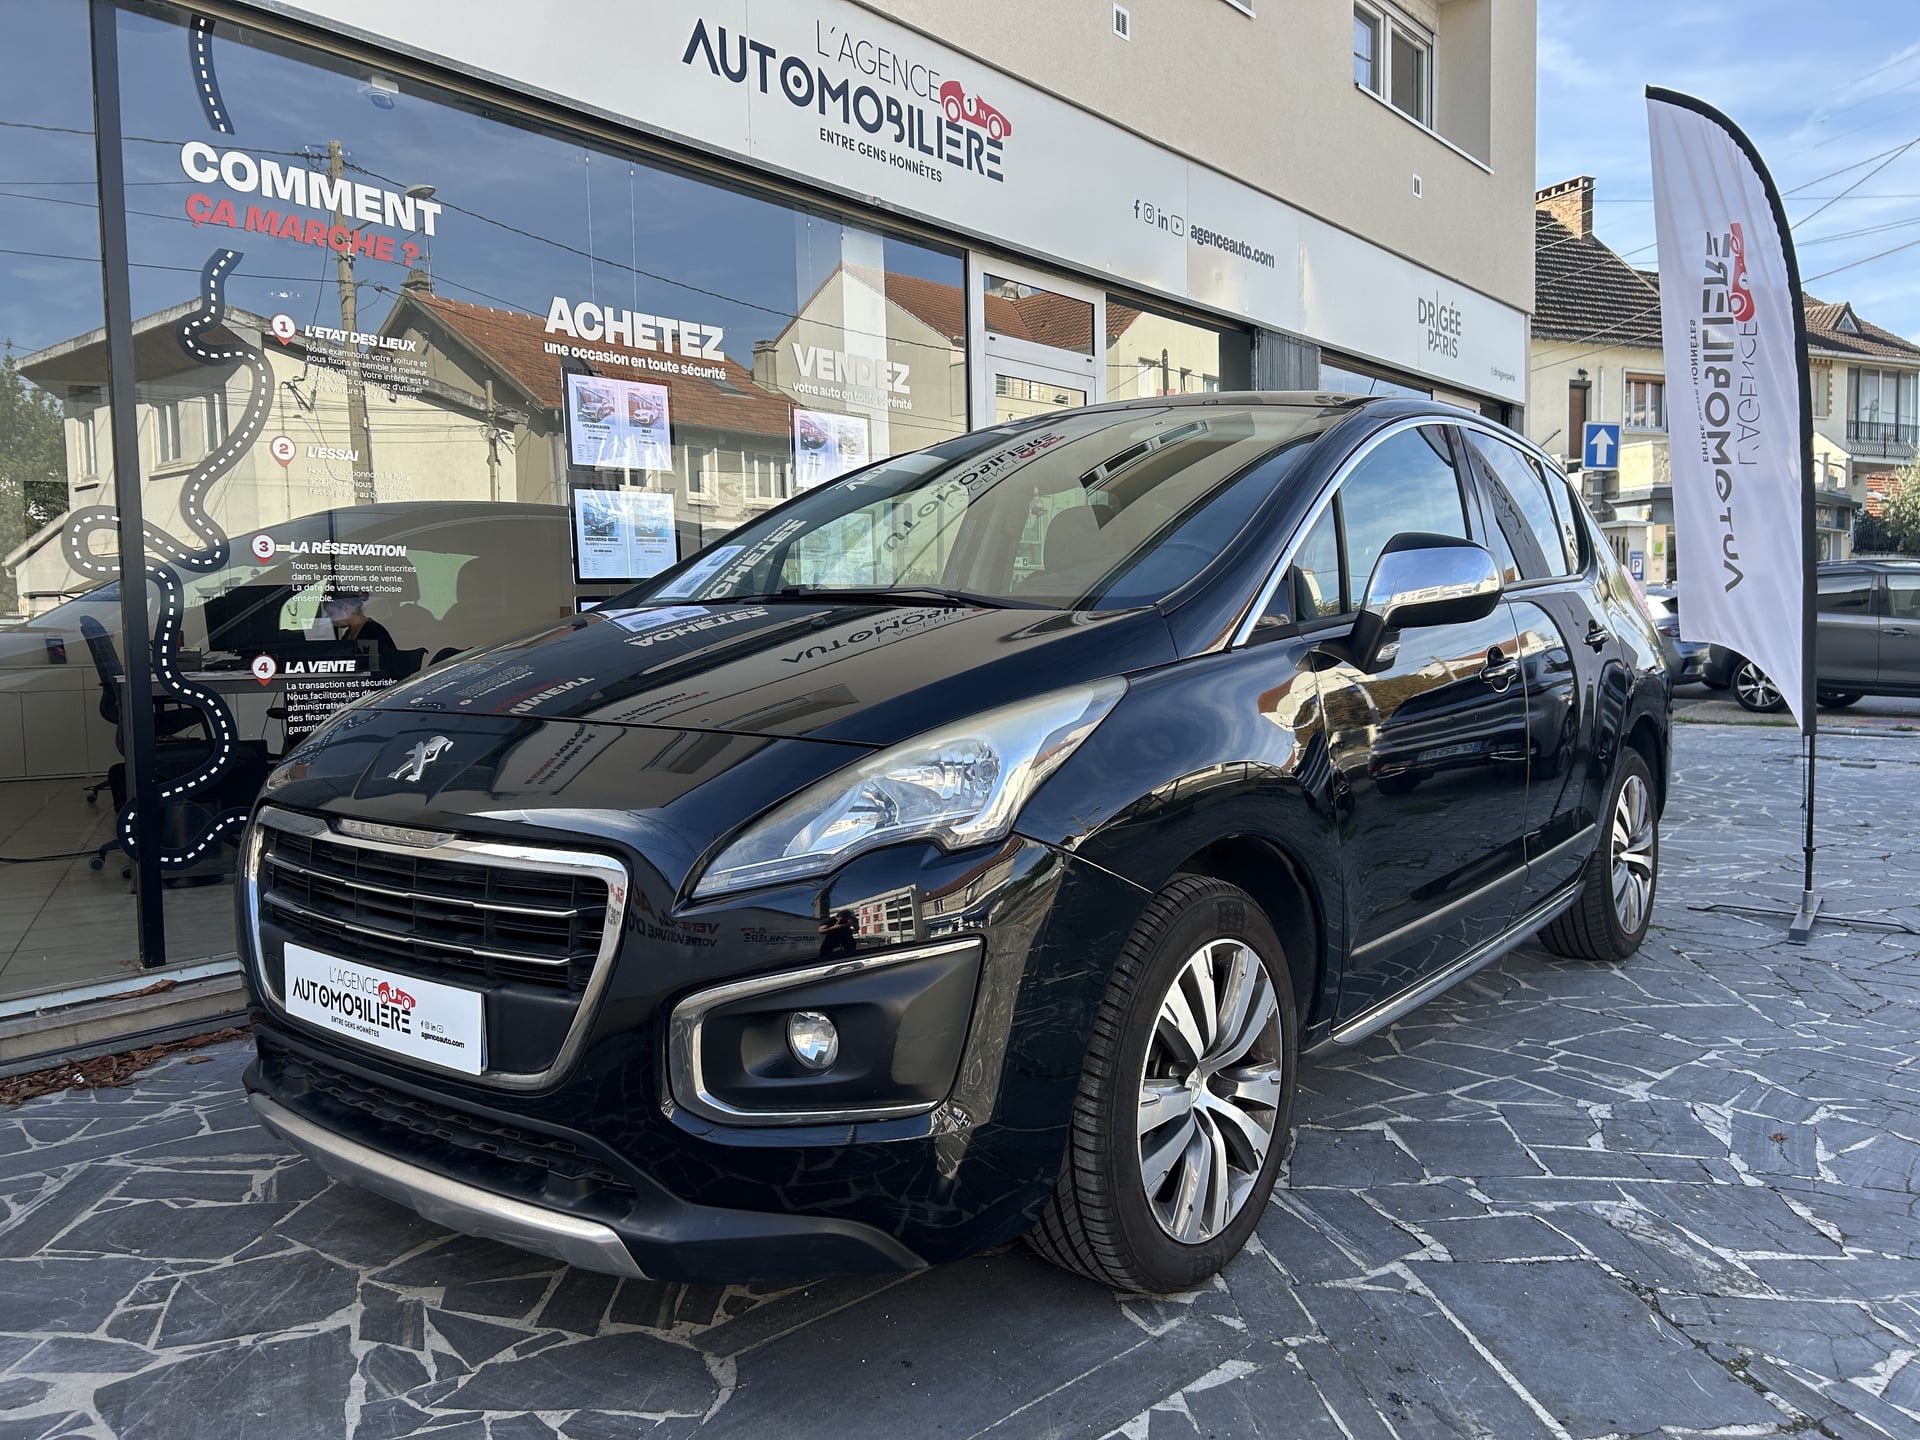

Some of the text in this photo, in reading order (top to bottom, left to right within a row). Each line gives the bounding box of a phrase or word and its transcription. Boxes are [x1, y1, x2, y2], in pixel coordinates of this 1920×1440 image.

[816, 19, 941, 104] L'AGENCE
[819, 127, 943, 183] ENTRE GENS HONNÊTES
[181, 141, 442, 236] COMMENT
[185, 192, 419, 266] ÇA MARCHE ?
[1190, 223, 1275, 269] agenceauto.com
[279, 321, 288, 333] 1
[544, 296, 725, 362] ACHETEZ
[305, 325, 417, 352] L'ETAT DES LIEUX
[1428, 328, 1458, 359] PARIS
[306, 345, 327, 354] Nous
[371, 354, 391, 363] votre
[393, 356, 418, 367] voiture
[419, 360, 427, 368] et
[544, 342, 726, 381] une occasion en toute sécurité
[306, 355, 327, 363] nous
[328, 357, 351, 367] fixons
[353, 361, 389, 372] ensemble
[398, 366, 427, 377] meilleur
[791, 342, 911, 394] VENDEZ
[354, 380, 391, 391] continuez
[361, 370, 383, 381] Votre
[408, 377, 421, 386] est
[423, 378, 430, 386] le
[792, 382, 819, 394] votre
[820, 385, 841, 399] auto
[279, 443, 288, 454] 2
[307, 446, 359, 462] L'ESSAI
[259, 541, 269, 552] 3
[290, 540, 407, 557] LA RÉSERVATION
[291, 561, 417, 573] Toutes les clauses sont inscrites
[291, 572, 405, 583] dans le compromis de vente.
[291, 583, 302, 592] La
[324, 583, 335, 592] de
[360, 585, 373, 593] est
[374, 584, 402, 593] choisie
[292, 594, 334, 603] ensemble.
[258, 663, 268, 674] 4
[285, 660, 356, 674] LA VENTE
[286, 682, 296, 690] La
[298, 681, 345, 691] transaction
[346, 680, 359, 688] est
[287, 692, 308, 701] Nous
[310, 691, 347, 701] facilitons
[348, 690, 360, 699] les
[288, 714, 303, 723] des
[329, 966, 378, 996] L'AGENCE
[331, 1015, 344, 1026] ENTRE
[356, 1024, 380, 1038] HONNÊTES
[421, 1030, 465, 1049] agenceauto.com
